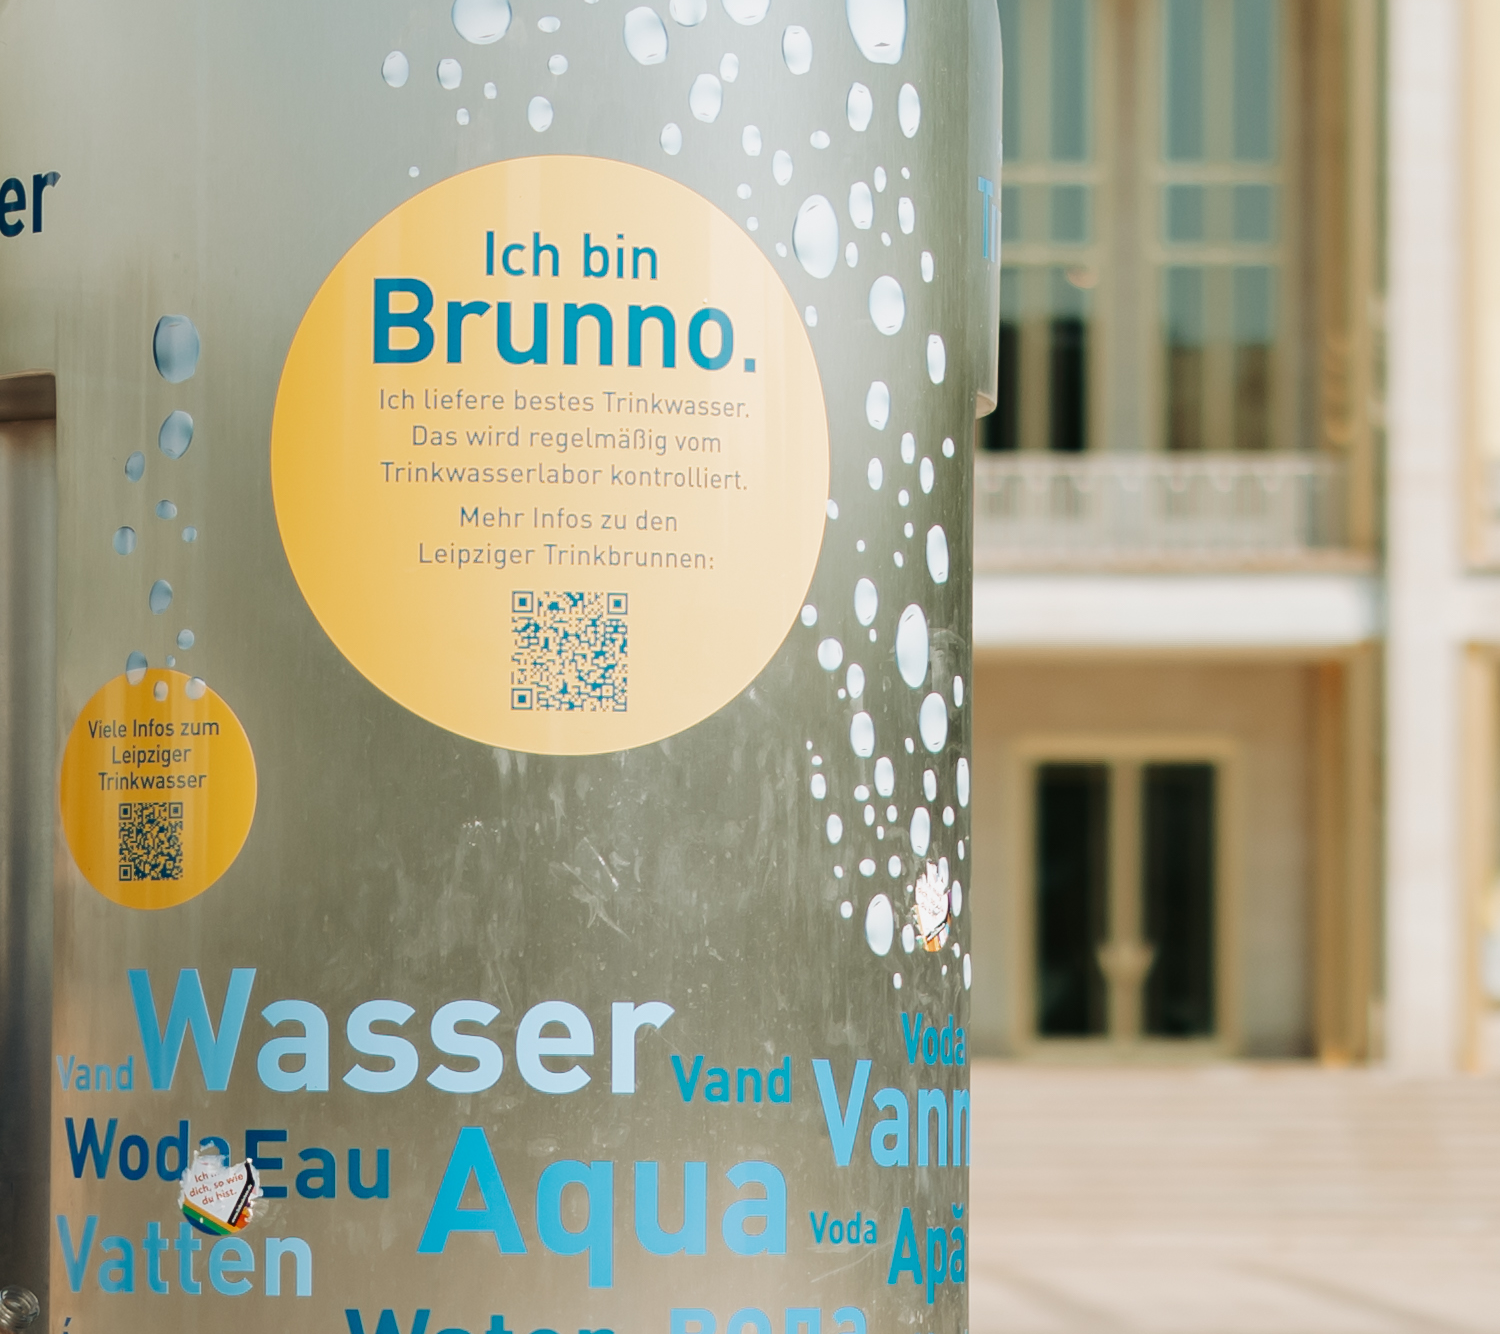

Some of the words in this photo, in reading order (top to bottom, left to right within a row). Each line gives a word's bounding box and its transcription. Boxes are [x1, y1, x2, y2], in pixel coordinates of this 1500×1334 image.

[485, 230, 560, 277] Ich
[583, 232, 658, 280] bin
[373, 277, 757, 373] Brunno.
[379, 389, 415, 411] Ich
[424, 389, 505, 411] liefere
[514, 389, 595, 413] bestes
[602, 391, 751, 418] Trinkwasser.
[411, 425, 458, 447] Das
[466, 425, 520, 447] wird
[529, 427, 668, 456] regelmäßig
[675, 434, 722, 454] vom
[380, 461, 603, 486] Trinkwasserlabor
[611, 464, 749, 491] kontrolliert.
[459, 506, 525, 529] Mehr
[533, 507, 593, 530] Infos
[600, 513, 627, 530] zu
[635, 509, 678, 532] den
[418, 542, 536, 569] Leipziger
[543, 543, 715, 570] Trinkbrunnen:
[88, 719, 127, 739] Viele
[133, 718, 175, 737] Infos
[180, 721, 220, 736] zum
[111, 744, 192, 768] Leipziger
[98, 771, 207, 791] Trinkwasser
[127, 968, 675, 1094] Wasser
[901, 1012, 966, 1066] Voda
[56, 1054, 135, 1092] Vand
[669, 1054, 792, 1104] Vand
[244, 1129, 391, 1200] Eau
[416, 1125, 788, 1289] Aqua
[809, 1210, 878, 1245] Voda
[56, 1214, 313, 1297] Vatten
[887, 1203, 967, 1305] Apă
